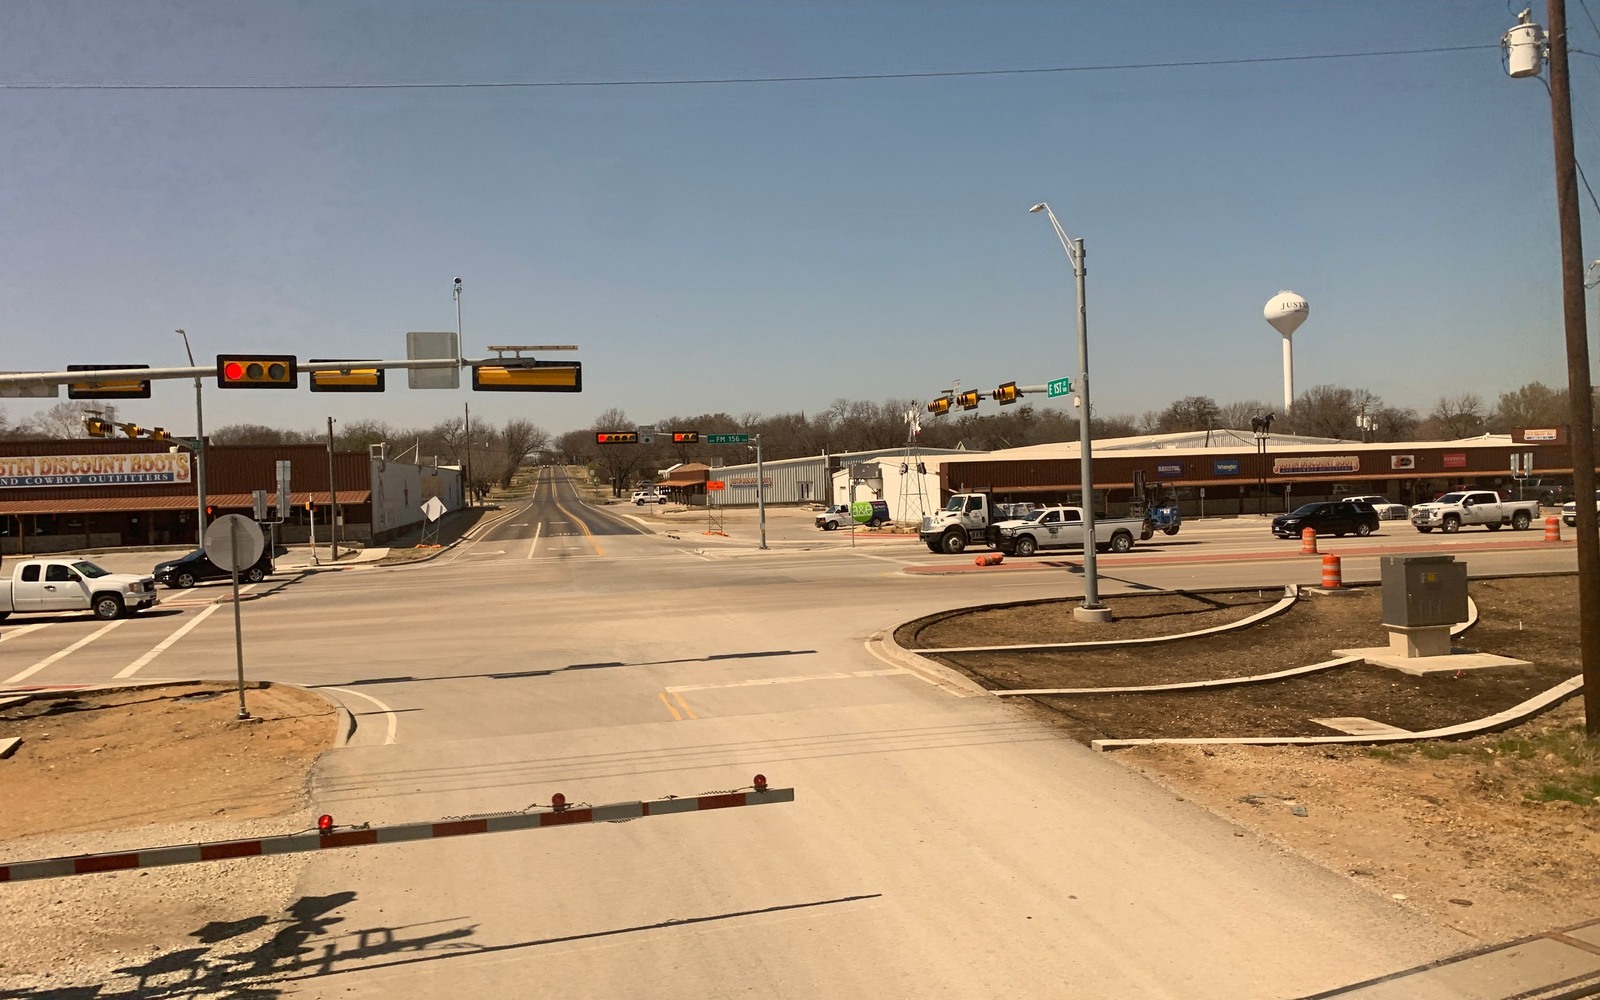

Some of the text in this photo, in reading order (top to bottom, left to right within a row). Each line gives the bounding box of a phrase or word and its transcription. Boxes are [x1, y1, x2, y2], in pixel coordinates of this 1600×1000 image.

[1049, 384, 1052, 395] E
[1053, 382, 1062, 394] 1ST
[38, 455, 126, 476] DISCOUNT
[130, 453, 190, 481] BOOTS
[25, 476, 82, 485] COWBOY
[88, 473, 169, 483] OUTFITTERS
[852, 504, 873, 517] a&e
